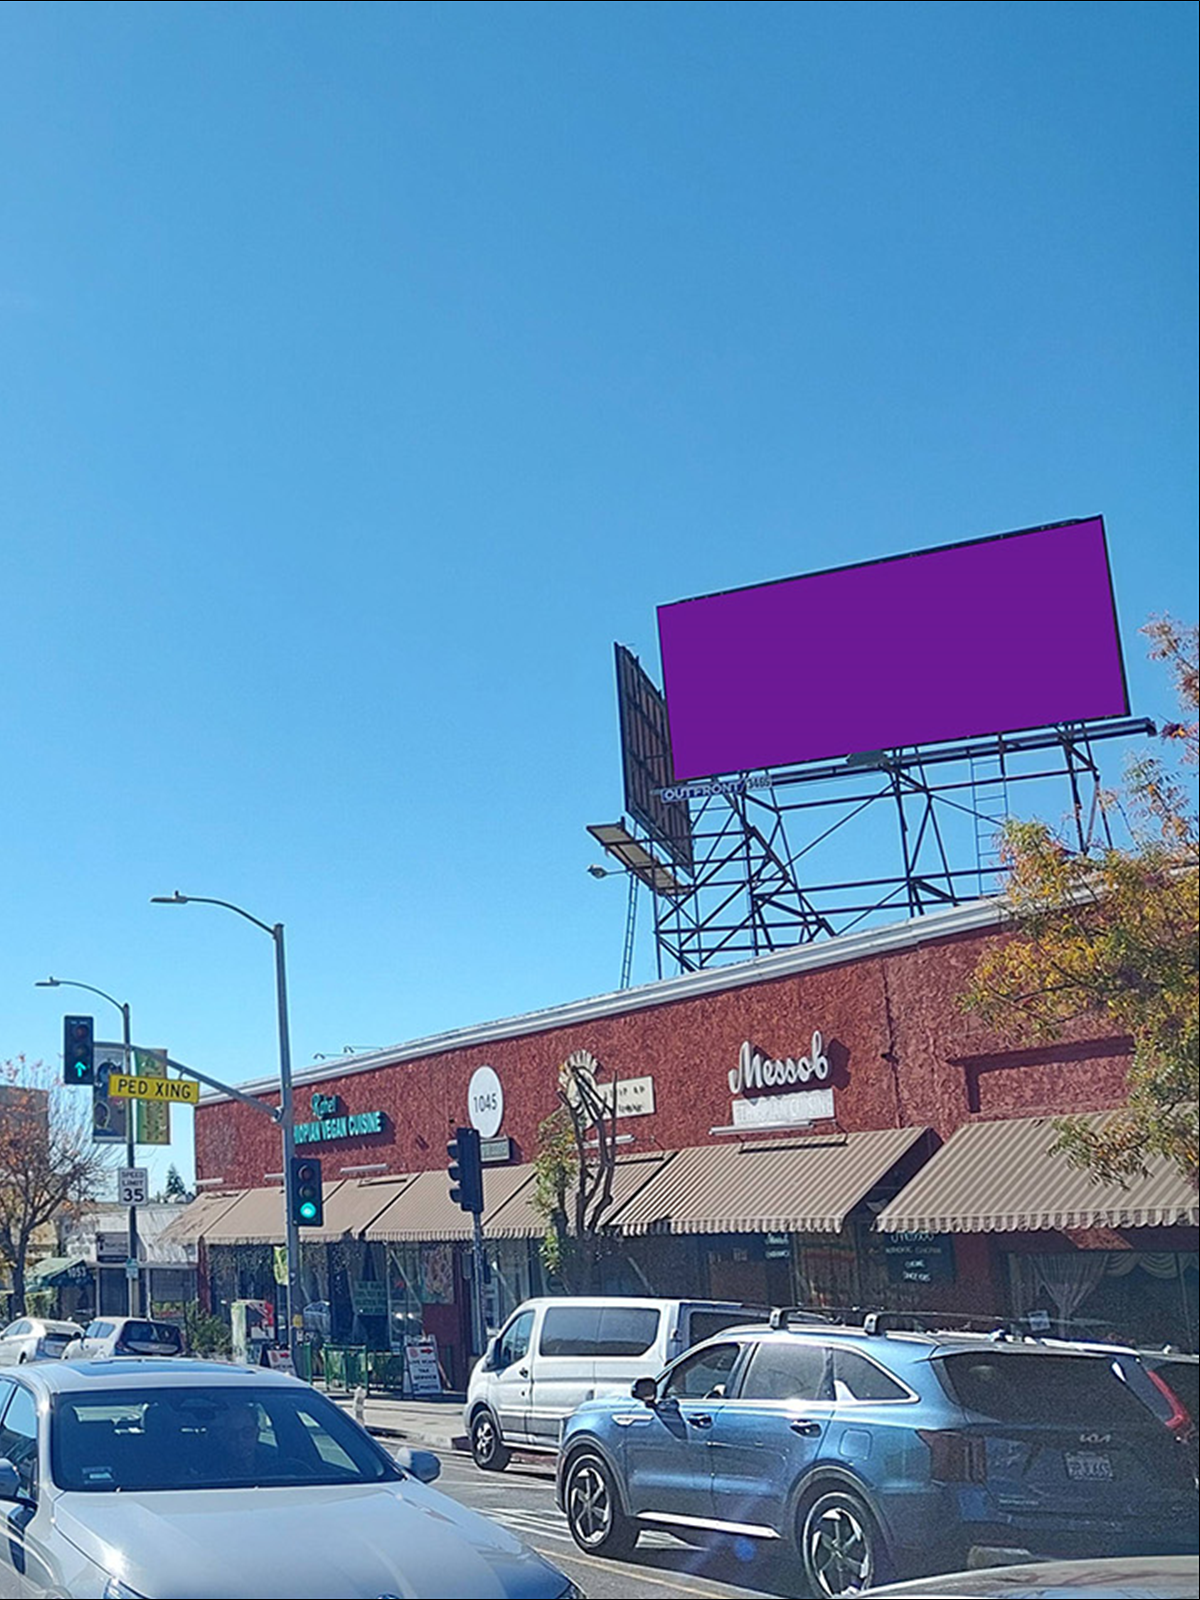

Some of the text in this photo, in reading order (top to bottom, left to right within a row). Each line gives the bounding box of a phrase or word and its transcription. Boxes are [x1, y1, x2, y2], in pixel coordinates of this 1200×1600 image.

[728, 1030, 828, 1094] Messob
[118, 1079, 191, 1099] PED XING
[473, 1092, 498, 1114] 1045
[121, 1171, 145, 1179] SPEED
[123, 1188, 144, 1202] 35
